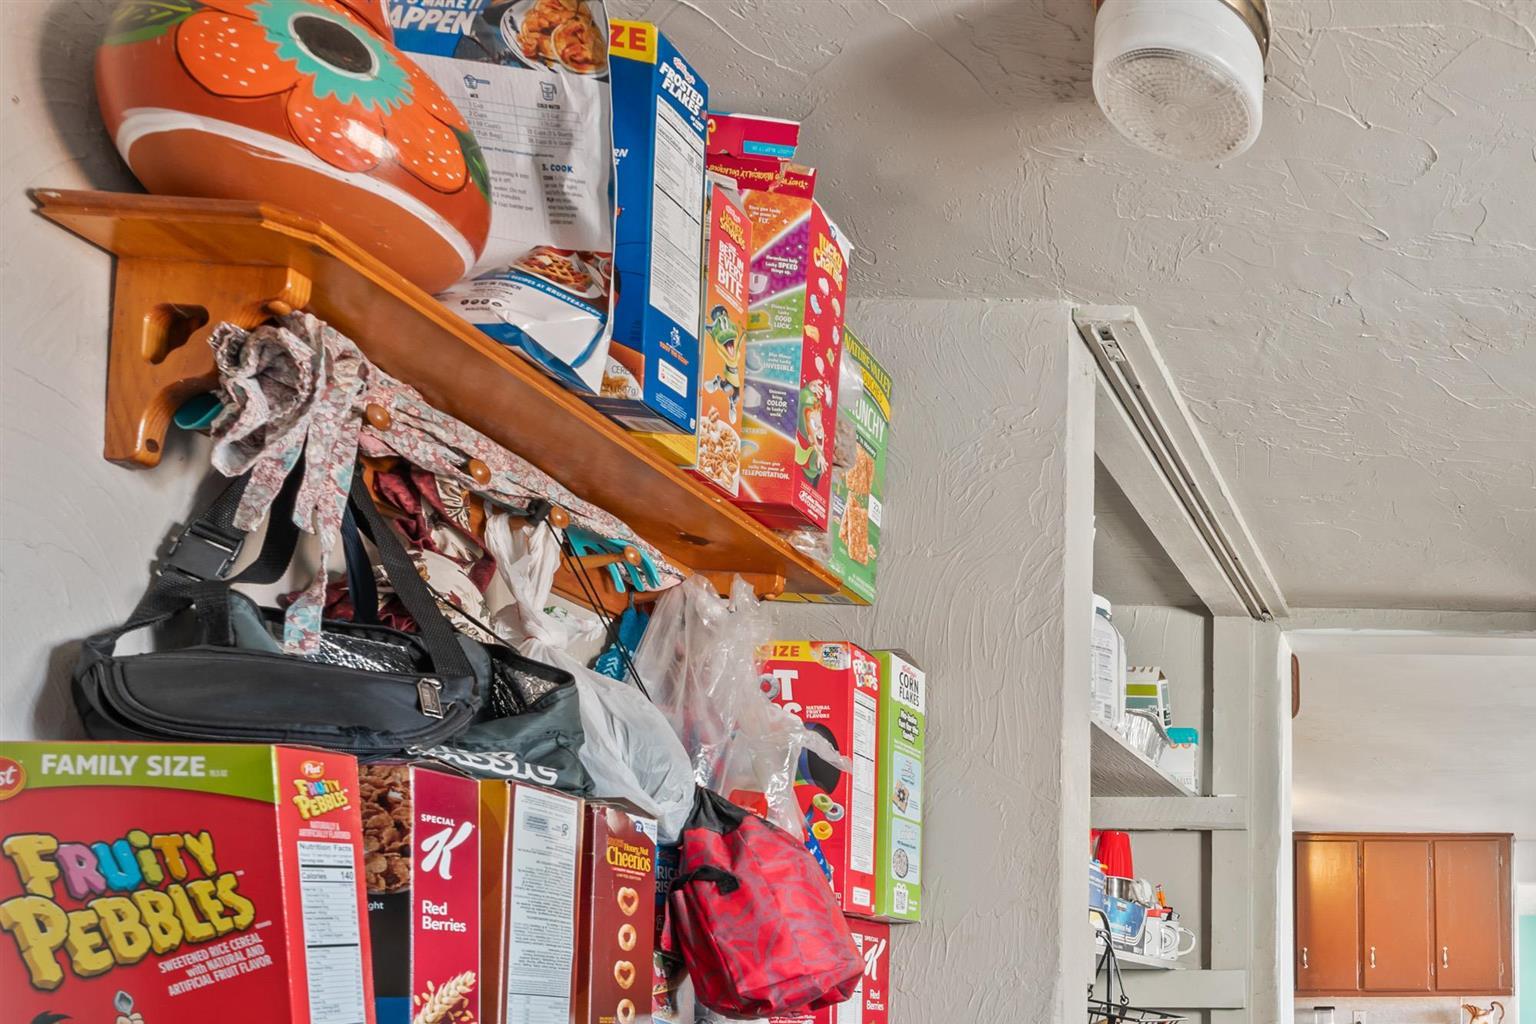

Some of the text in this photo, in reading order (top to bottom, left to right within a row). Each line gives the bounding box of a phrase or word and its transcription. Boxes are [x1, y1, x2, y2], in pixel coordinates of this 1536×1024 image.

[391, 8, 477, 36] APPEN
[609, 24, 647, 51] ZE
[659, 61, 704, 107] FROSTED
[661, 78, 700, 116] FLAKES
[719, 241, 737, 263] BEST
[718, 254, 744, 283] EVERY
[778, 262, 798, 271] SPEED
[717, 268, 743, 301] BITE
[774, 315, 792, 323] GOOD
[844, 332, 892, 399] NATURE VALLEY
[767, 399, 787, 407] COLOR
[850, 399, 885, 443] UNCHY
[899, 671, 919, 693] CORN
[899, 686, 920, 707] FLAKES
[41, 754, 206, 777] FAMILY SIZE
[292, 791, 349, 819] PEBBLES
[420, 813, 455, 826] SPECIAL
[420, 821, 474, 880] K
[606, 846, 651, 873] Cheerios
[301, 871, 353, 881] Calories 140
[421, 900, 448, 916] Red
[0, 872, 256, 991] PEBBLES
[421, 916, 467, 933] Berries
[864, 935, 879, 943] SPECIAL
[158, 933, 263, 974] SWEETENED RICE CEREAL
[186, 945, 266, 979] with NATURAL AND
[864, 938, 887, 981] K
[168, 956, 273, 997] ARTIFICIAL FRUIT FLAVOR
[866, 999, 885, 1011] Berries
[869, 988, 881, 1000] Red
